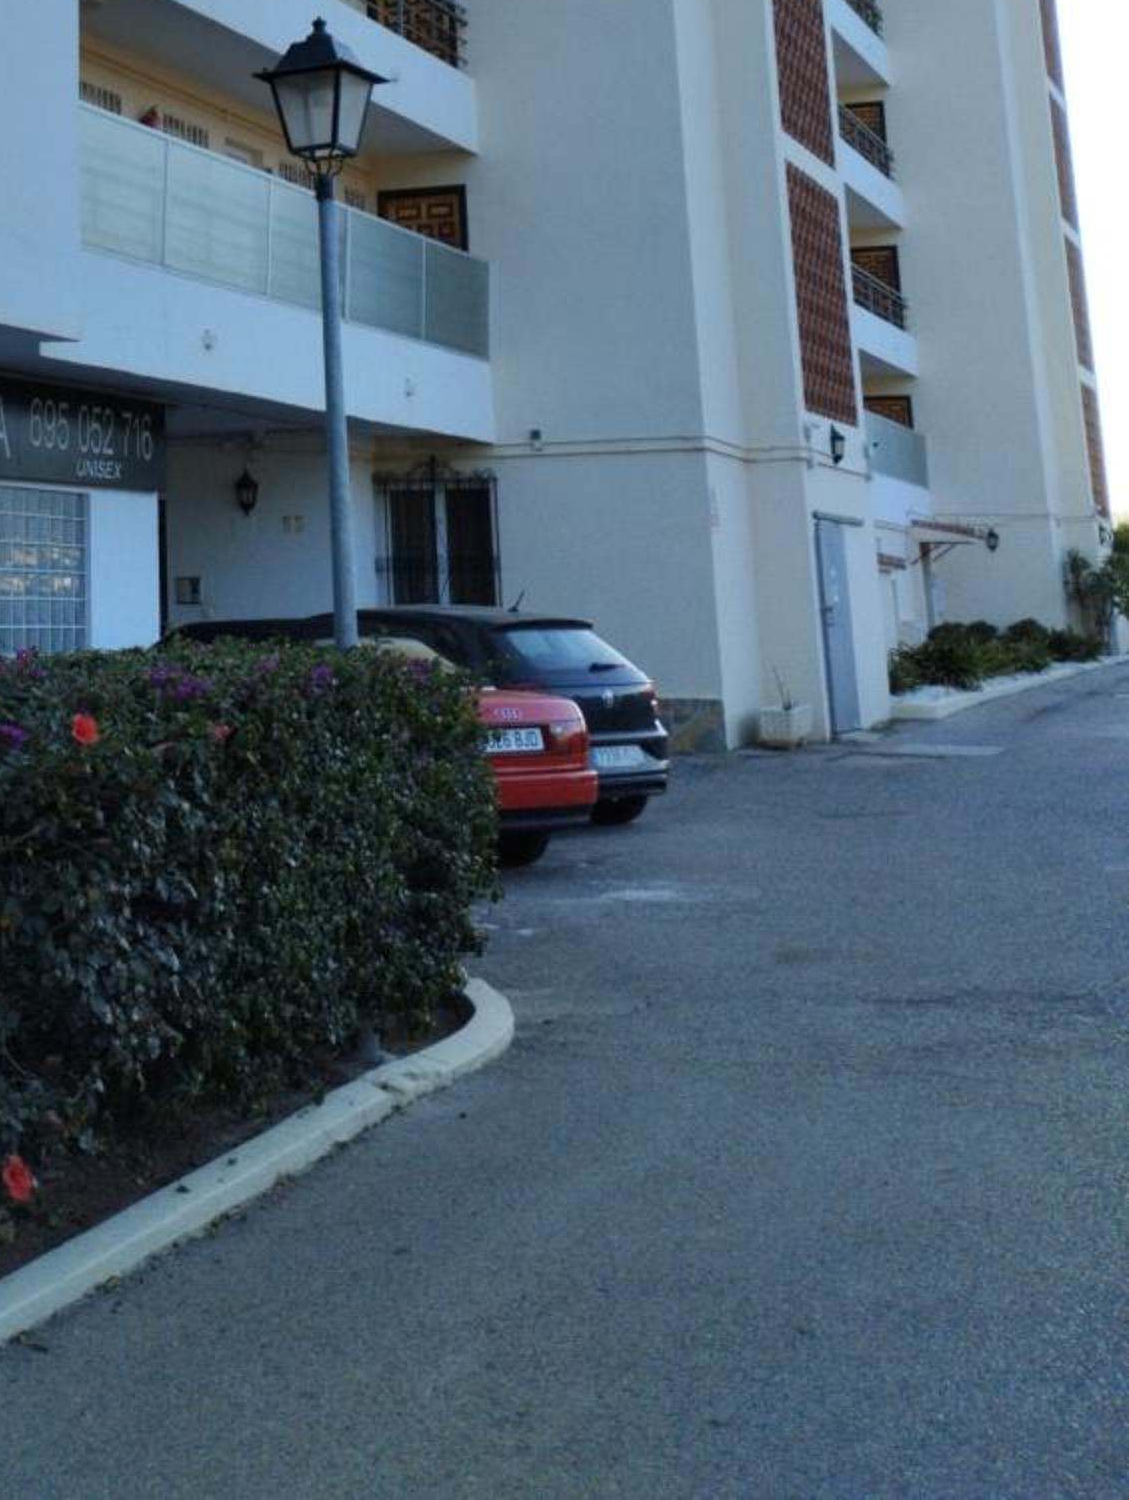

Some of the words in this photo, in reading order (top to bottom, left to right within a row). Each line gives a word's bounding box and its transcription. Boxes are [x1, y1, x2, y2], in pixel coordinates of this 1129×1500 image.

[28, 396, 71, 452] 695
[76, 403, 115, 457] 052
[120, 411, 154, 462] 716
[75, 458, 122, 480] UNISEX
